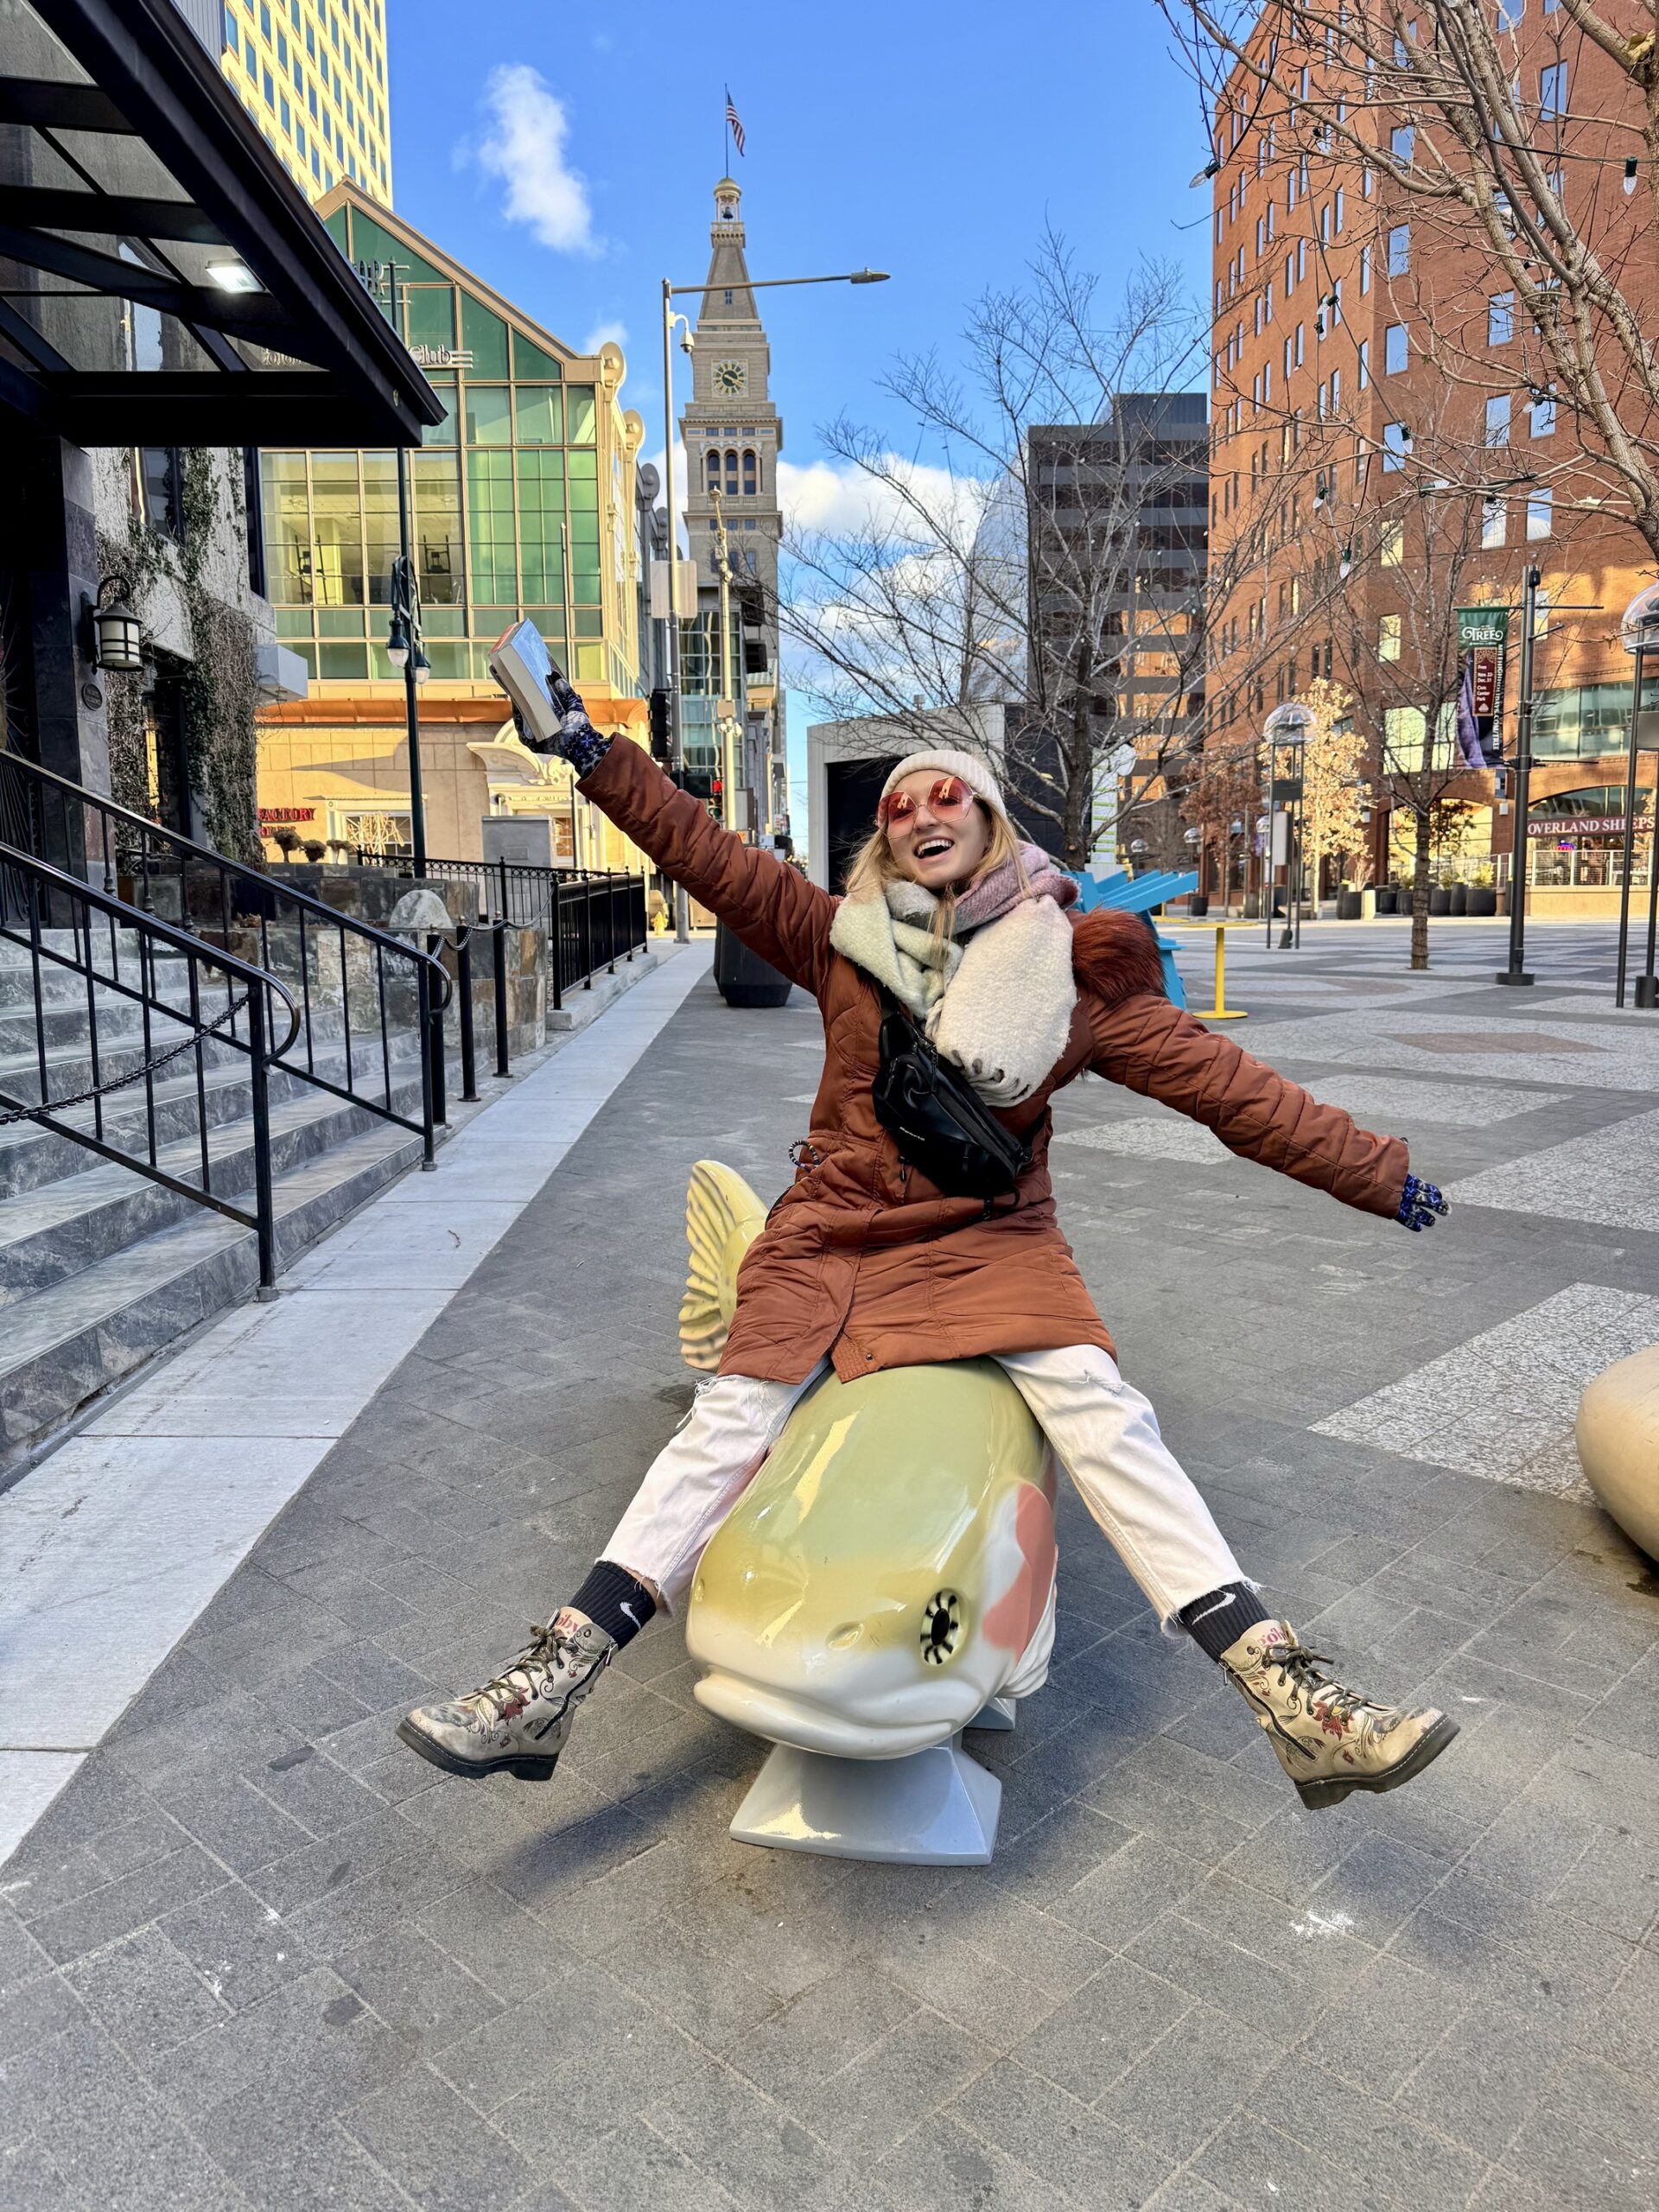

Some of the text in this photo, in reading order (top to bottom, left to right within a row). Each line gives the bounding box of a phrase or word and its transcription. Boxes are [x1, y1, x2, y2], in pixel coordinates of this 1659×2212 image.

[408, 344, 452, 365] Club
[1462, 626, 1503, 641] TREE
[257, 808, 316, 822] FACTORY
[1528, 820, 1599, 835] OVERLAND
